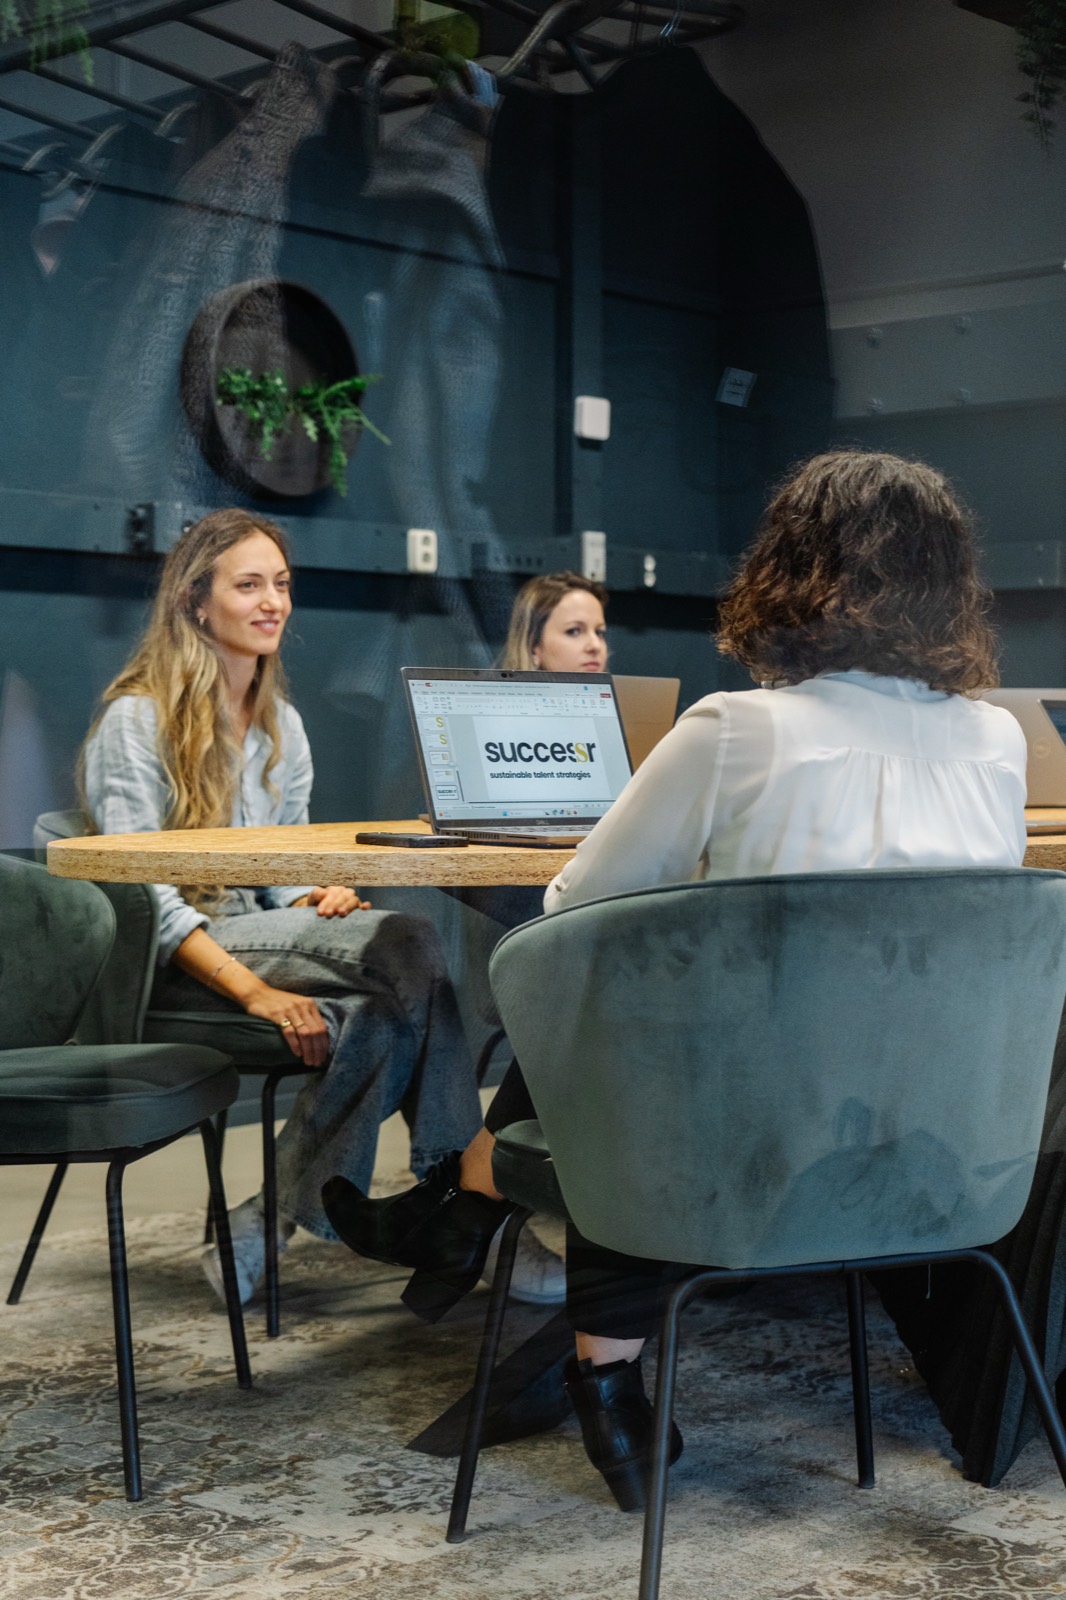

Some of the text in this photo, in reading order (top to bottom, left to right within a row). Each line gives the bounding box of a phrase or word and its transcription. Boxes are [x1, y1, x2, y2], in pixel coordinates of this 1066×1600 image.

[490, 771, 591, 780] sustainable talent strategies
